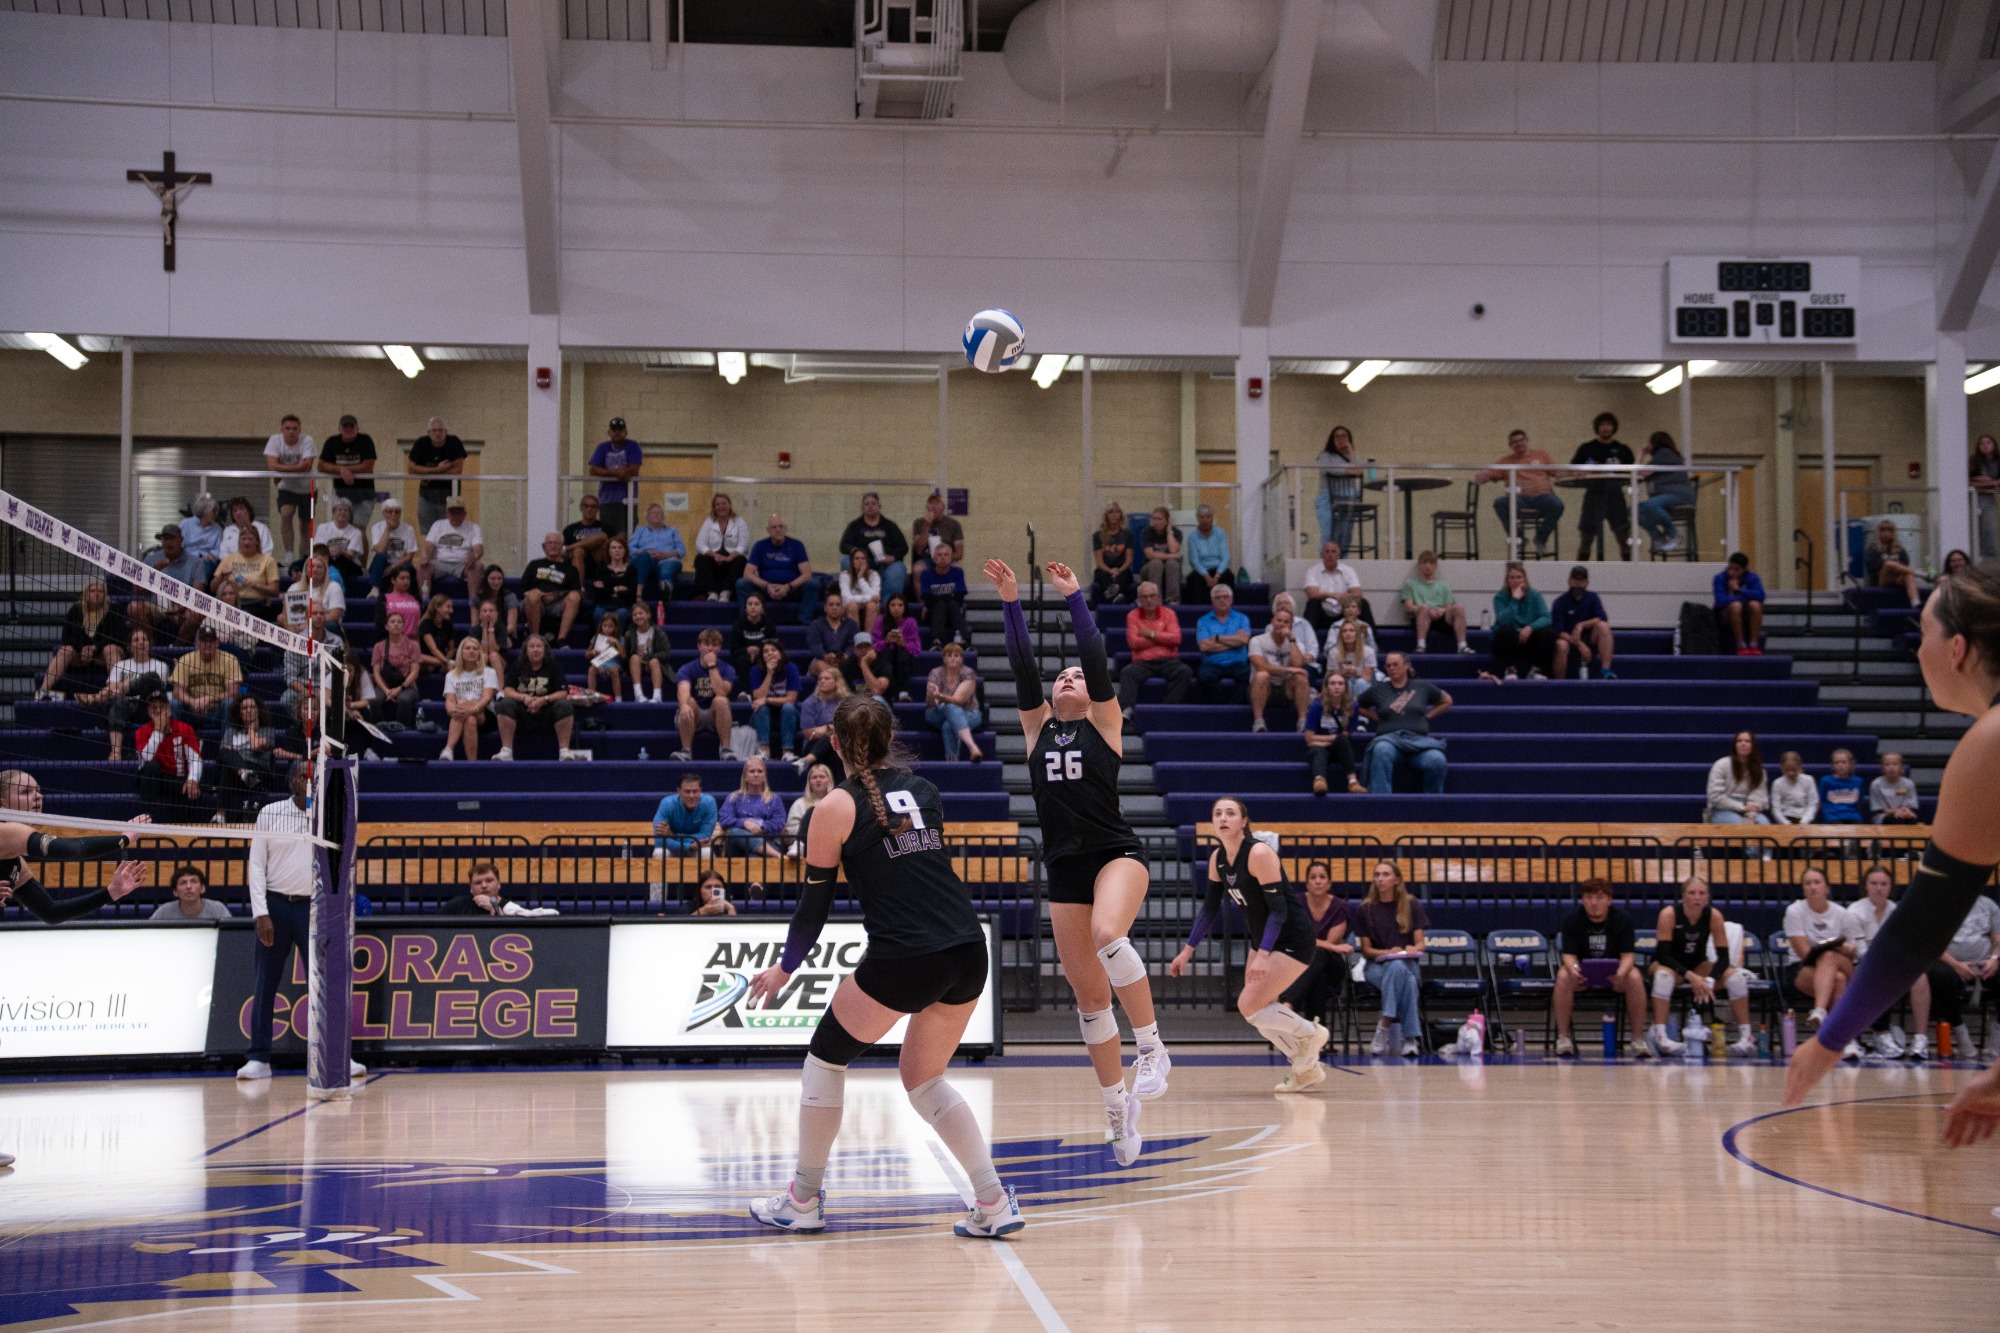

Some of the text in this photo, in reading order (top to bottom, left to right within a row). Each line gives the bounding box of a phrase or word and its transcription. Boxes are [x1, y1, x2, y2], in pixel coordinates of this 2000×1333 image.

[1683, 293, 1715, 304] HOME
[1810, 293, 1846, 304] GUEST
[287, 594, 307, 602] POINT
[1045, 750, 1083, 781] 26
[885, 790, 926, 829] 9
[883, 829, 942, 858] LORAS
[1227, 888, 1248, 906] 14
[704, 942, 872, 968] AMERIC
[35, 1023, 88, 1032] DEVELOP
[94, 1021, 151, 1031] DEDICATE
